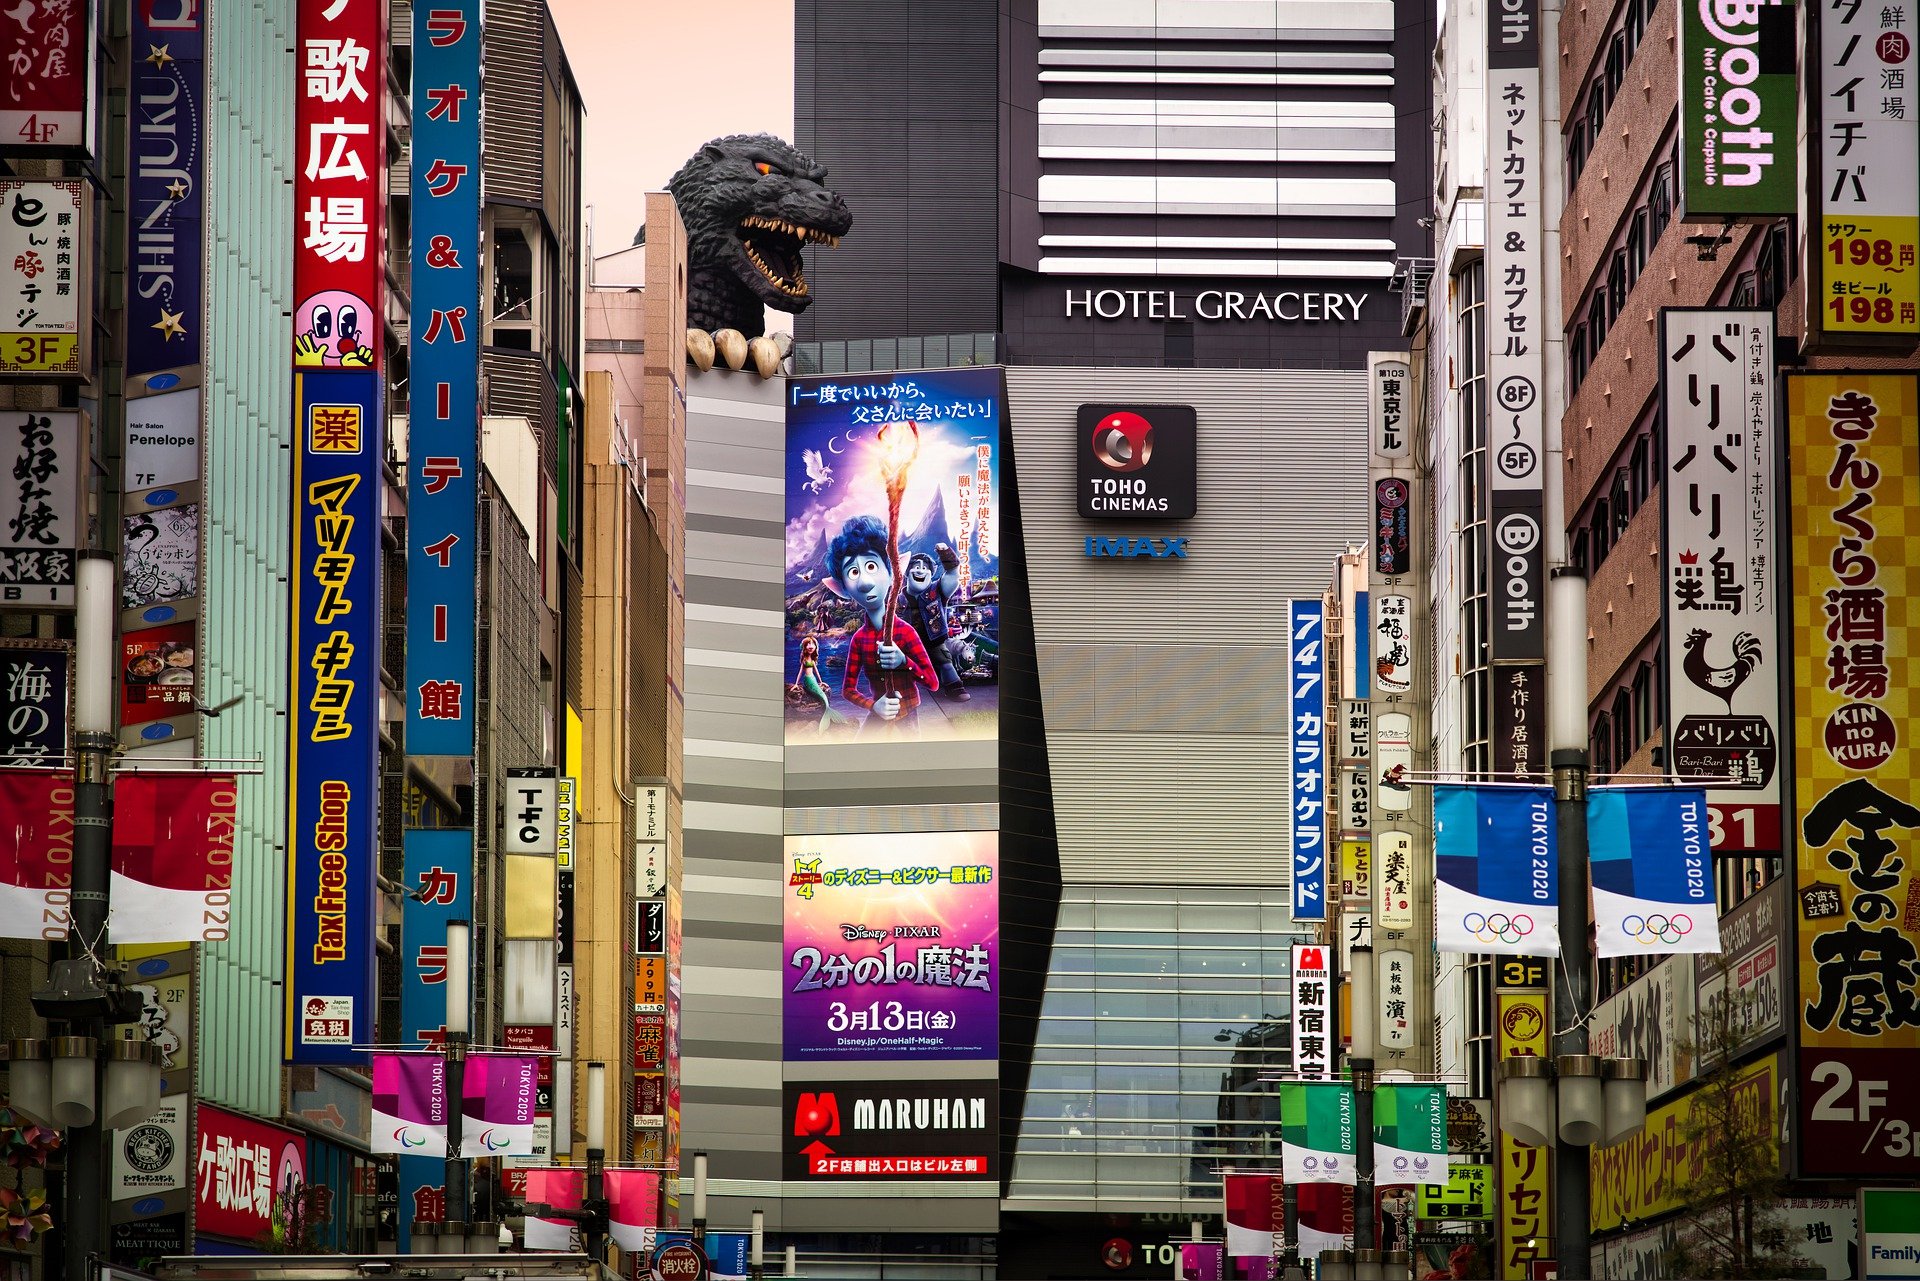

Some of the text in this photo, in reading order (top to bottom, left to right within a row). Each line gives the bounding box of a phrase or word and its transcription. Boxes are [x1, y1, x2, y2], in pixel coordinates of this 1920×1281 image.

[1875, 6, 1911, 119] 鮮肉酒場
[19, 114, 59, 143] 4F
[138, 76, 193, 299] SHINJUKU
[1502, 83, 1528, 358] ネットカフェ & カプセル
[1827, 223, 1873, 238] サワー
[56, 212, 71, 296] 豚・焼肉酒房
[1828, 239, 1894, 267] 198
[1832, 281, 1892, 296] 生ビール
[1065, 289, 1368, 321] HOTEL GRACERY
[1829, 297, 1895, 324] 198
[15, 337, 59, 364] 3F
[1379, 369, 1405, 377] 第103
[793, 382, 926, 405] 「一度でいいから、
[1504, 385, 1529, 402] 8F
[852, 399, 991, 424] 父さんに会いたい」
[1383, 380, 1402, 449] 東京ビル
[129, 434, 195, 447] Penelope
[315, 410, 357, 450] 薬
[1750, 392, 1764, 466] 炭火やきとり
[1504, 452, 1530, 470] 5F
[9, 414, 59, 544] お好み焼
[136, 474, 155, 485] 7F
[1091, 479, 1146, 494] TOHO
[1091, 497, 1169, 511] CINEMAS
[172, 521, 186, 532] 6F
[1085, 536, 1188, 557] IMAX
[1825, 391, 1889, 699] きんくら酒場
[1384, 577, 1402, 585] 3F
[1495, 513, 1541, 632] Booth
[1751, 555, 1766, 613] 樽生ワイン
[310, 474, 361, 741] マツモトキヨシ
[126, 645, 142, 655] 5F
[148, 692, 191, 704] 一品鍋
[1510, 671, 1530, 781] 手作り居酒屋
[1834, 707, 1878, 725] KIN
[1679, 723, 1769, 745] バリバリ
[1846, 727, 1875, 740] no
[1679, 756, 1724, 767] Bari-Bari
[1832, 741, 1892, 763] KURA
[1351, 772, 1369, 828] にいむら
[315, 780, 350, 851] Shop
[518, 789, 543, 843] TFC
[1386, 813, 1404, 821] 5F
[42, 774, 75, 941] TOKYO 2020
[202, 776, 237, 942] TOKYO 2020
[1531, 801, 1549, 900] TOKYO 2020
[1680, 801, 1705, 899] TOKYO 2020
[797, 884, 815, 900] 4
[1804, 890, 1839, 903] 今宵も
[1802, 776, 1920, 1037] 金の蔵
[648, 903, 662, 942] ダーツ
[894, 926, 941, 938] PIXAR
[1387, 932, 1405, 940] 6F
[790, 943, 991, 993] 2分の1の魔法
[1390, 960, 1402, 996] 鉄板焼
[1503, 964, 1543, 985] 3F
[167, 990, 185, 1003] 2F
[560, 970, 570, 1029] ヘアースペース
[310, 1020, 345, 1036] 免税
[827, 1000, 957, 1032] 3月13日(金)
[636, 1026, 661, 1062] 麻雀
[837, 1036, 944, 1047] Disney.jp/OneHalf-Magic
[1388, 1051, 1406, 1059] 7F
[431, 1061, 443, 1122] TOKYO 2020
[517, 1063, 532, 1121] TOKYO 2020
[1811, 1060, 1889, 1122] 2F
[854, 1098, 985, 1129] MARUHAN
[1340, 1092, 1351, 1151] TOKYO 2020
[1430, 1092, 1442, 1151] TOKYO 2020
[129, 1128, 171, 1149] BEEF KITCHEN
[137, 1159, 163, 1170] STAND
[198, 1132, 271, 1218] ケ歌広場
[817, 1158, 978, 1173] 2F店舗出入口はビル左側
[1425, 1181, 1485, 1202] ロード
[662, 1258, 697, 1274] 消火栓
[1142, 1244, 1175, 1264] TO
[1871, 1245, 1920, 1264] Family
